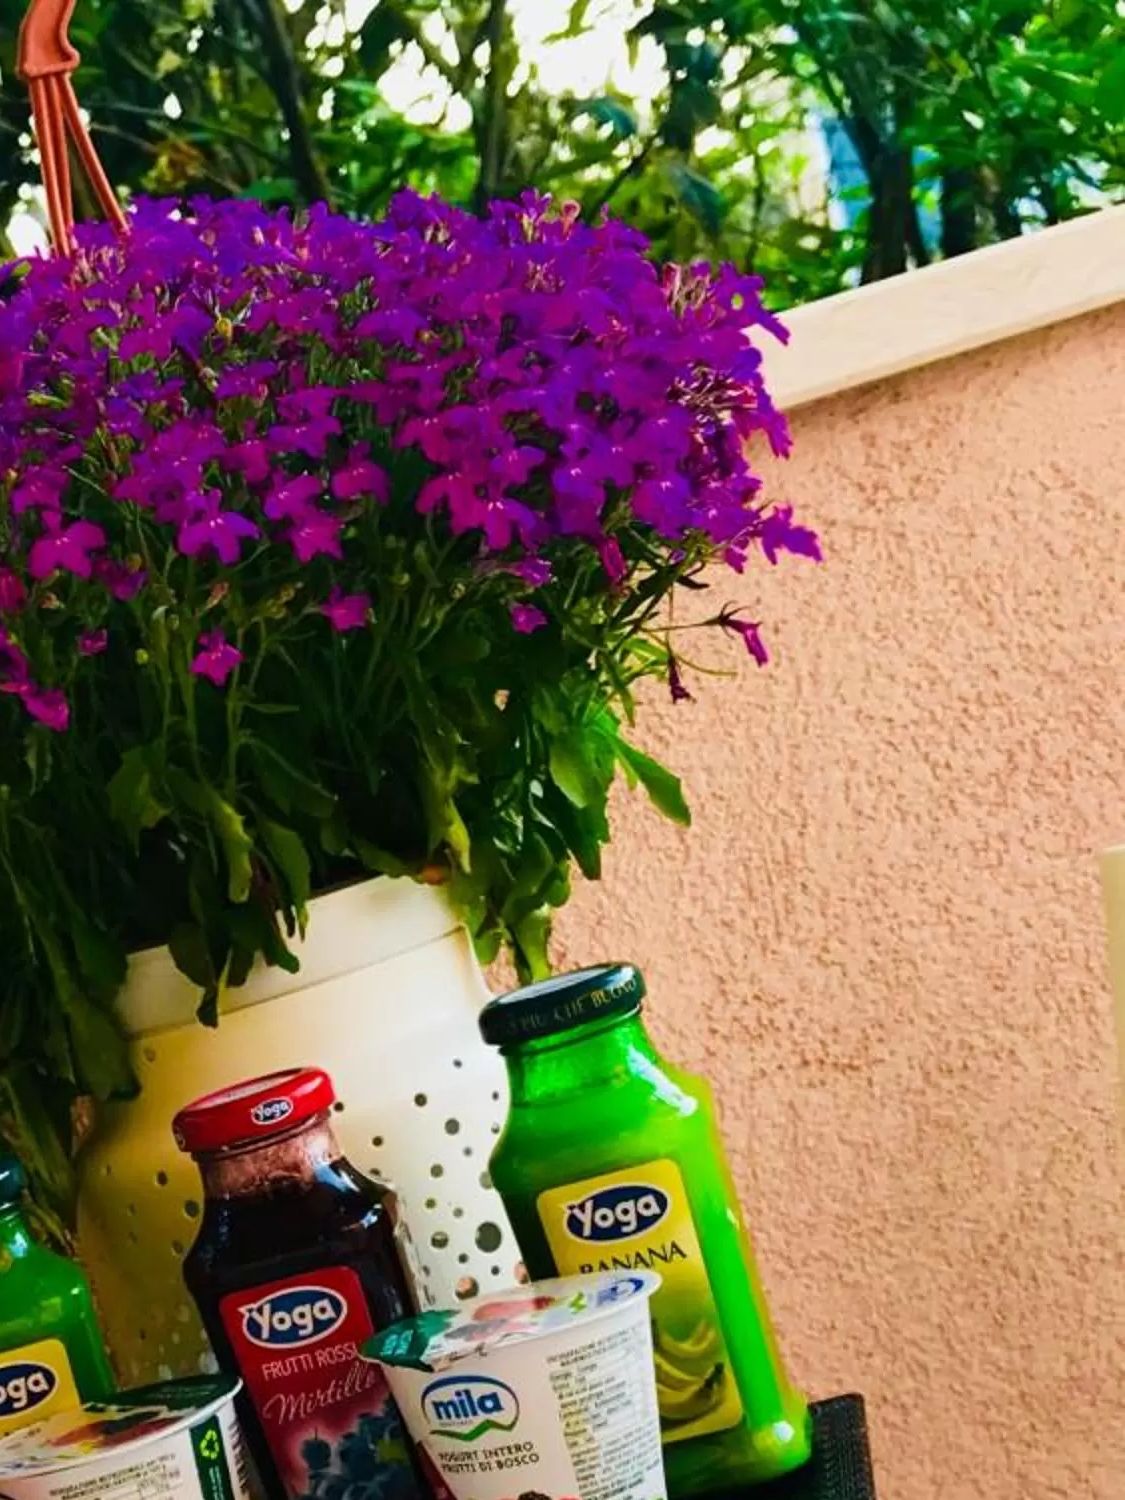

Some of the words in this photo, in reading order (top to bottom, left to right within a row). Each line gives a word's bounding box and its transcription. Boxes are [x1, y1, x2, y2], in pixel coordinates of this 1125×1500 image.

[256, 1101, 289, 1121] Yoga
[569, 1194, 661, 1237] Yoga
[250, 1298, 337, 1340] Yoga
[261, 1354, 314, 1381] FRUTTI
[316, 1342, 359, 1367] ROSSI
[432, 1388, 505, 1420] mila
[438, 1450, 478, 1462] YOGURT
[482, 1441, 534, 1460] INTERO
[441, 1463, 476, 1473] FRUTTI
[495, 1453, 540, 1470] BOSCO
